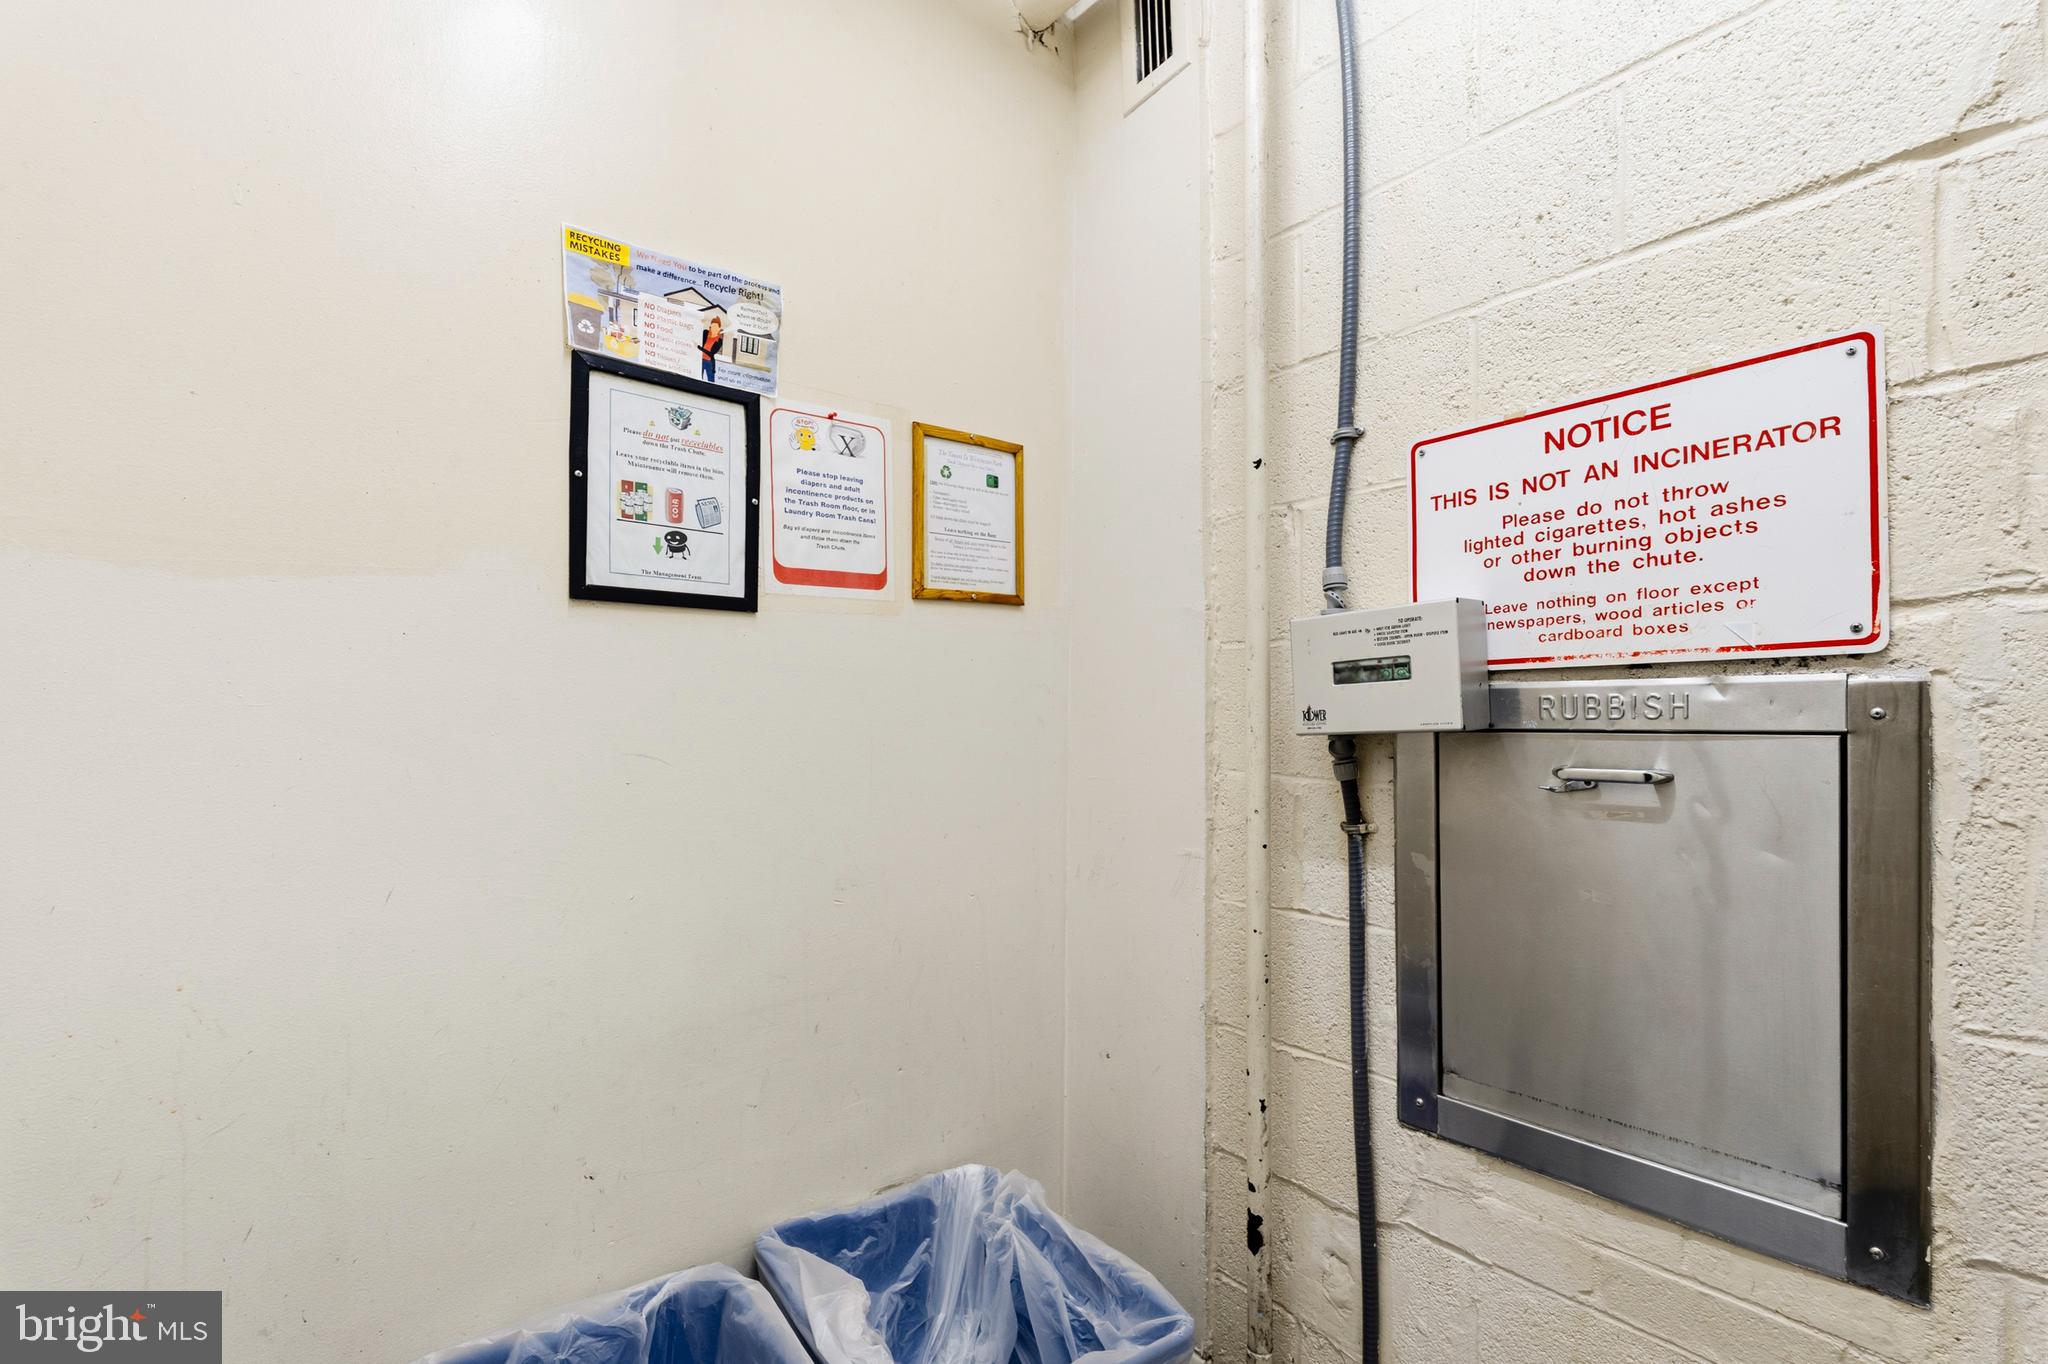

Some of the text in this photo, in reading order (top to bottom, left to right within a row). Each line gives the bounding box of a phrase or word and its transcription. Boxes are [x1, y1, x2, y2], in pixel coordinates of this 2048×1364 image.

[570, 231, 621, 252] RECYCLING
[570, 240, 620, 261] MISTAKES
[636, 264, 656, 275] make
[703, 279, 736, 295] Recycle
[738, 287, 764, 301] Right!
[688, 265, 696, 273] to
[698, 267, 706, 275] be
[708, 270, 721, 280] part
[723, 273, 731, 281] of
[732, 275, 742, 284] the
[744, 280, 767, 292] process
[768, 286, 780, 295] and
[644, 302, 656, 311] NO
[644, 312, 655, 320] NO
[644, 321, 656, 330] NO
[644, 331, 656, 339] NO
[645, 340, 656, 348] NO
[623, 427, 642, 436] Please
[642, 430, 654, 440] do
[655, 433, 669, 442] not
[1544, 403, 1672, 454] NOTICE
[615, 450, 634, 459] Leave
[1430, 415, 1842, 512] THIS IS NOT AN INCINERATOR
[796, 468, 864, 485] Please stop leaving
[800, 479, 861, 494] diapers and adult
[785, 486, 833, 499] incontinence
[835, 494, 864, 504] products
[798, 498, 819, 507] Trash
[821, 501, 841, 510] Room
[842, 504, 860, 513] floor,
[1502, 480, 1730, 529] Please do not throw
[784, 507, 877, 524] Laundry Room Trash Cans!
[1464, 494, 1787, 554] lighted cigarettes, hot ashes
[1483, 519, 1759, 569] or other burning objects
[641, 568, 653, 576] The
[653, 569, 689, 581] Management
[1523, 549, 1703, 582] down the chute.
[1485, 576, 1760, 615] Leave nothing on floor except
[1487, 598, 1757, 631] newspapers, wood articles or
[1538, 622, 1689, 643] cardboard boxes
[1538, 692, 1690, 721] RUBBISH
